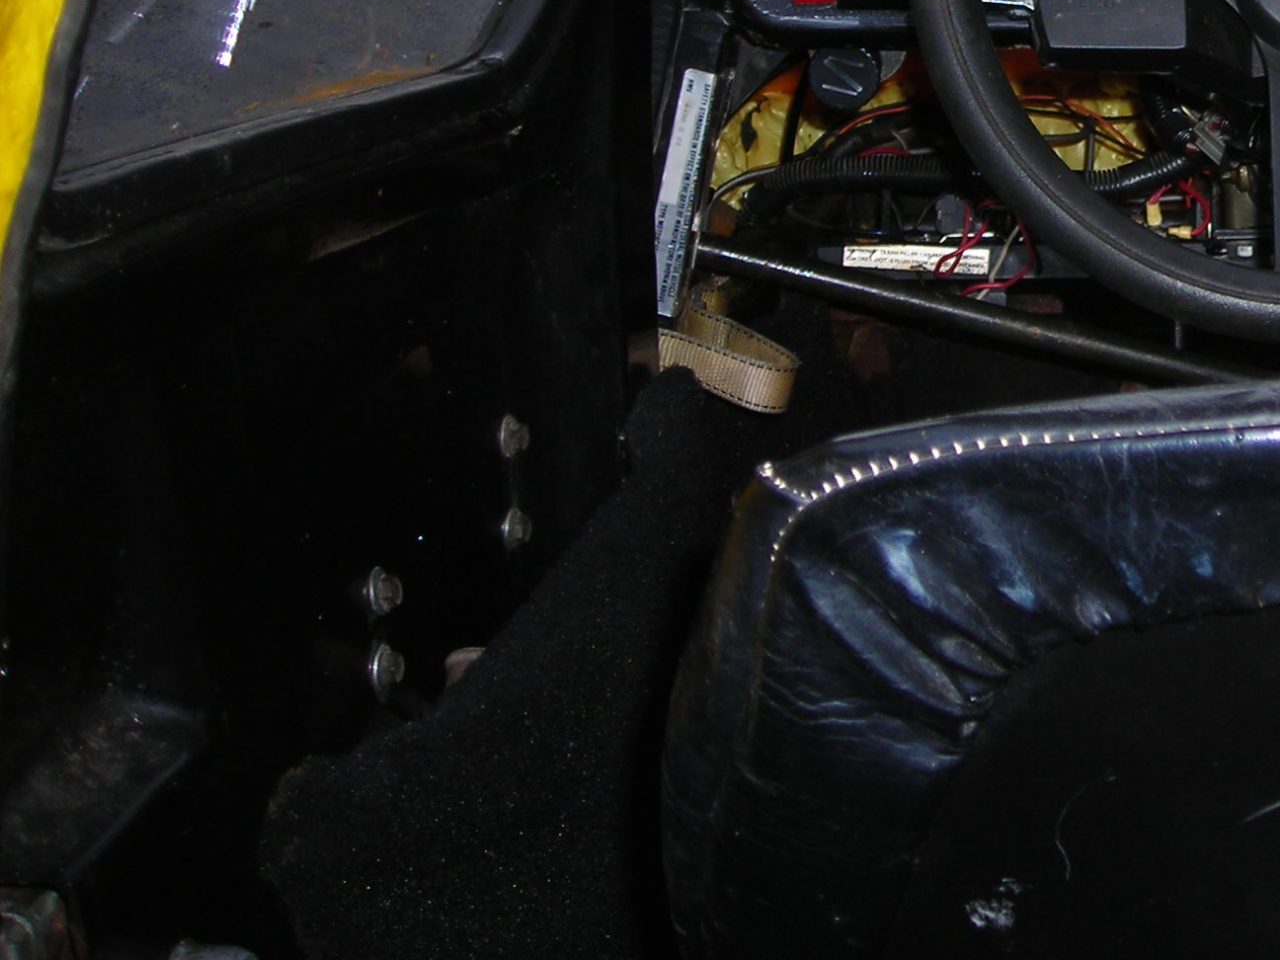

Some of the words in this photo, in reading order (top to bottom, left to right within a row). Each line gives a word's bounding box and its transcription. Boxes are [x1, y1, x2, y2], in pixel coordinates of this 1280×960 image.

[702, 84, 711, 106] SAFETY
[692, 107, 706, 141] STANDARDS
[687, 150, 696, 172] EFFECT
[659, 204, 668, 218] TYPE
